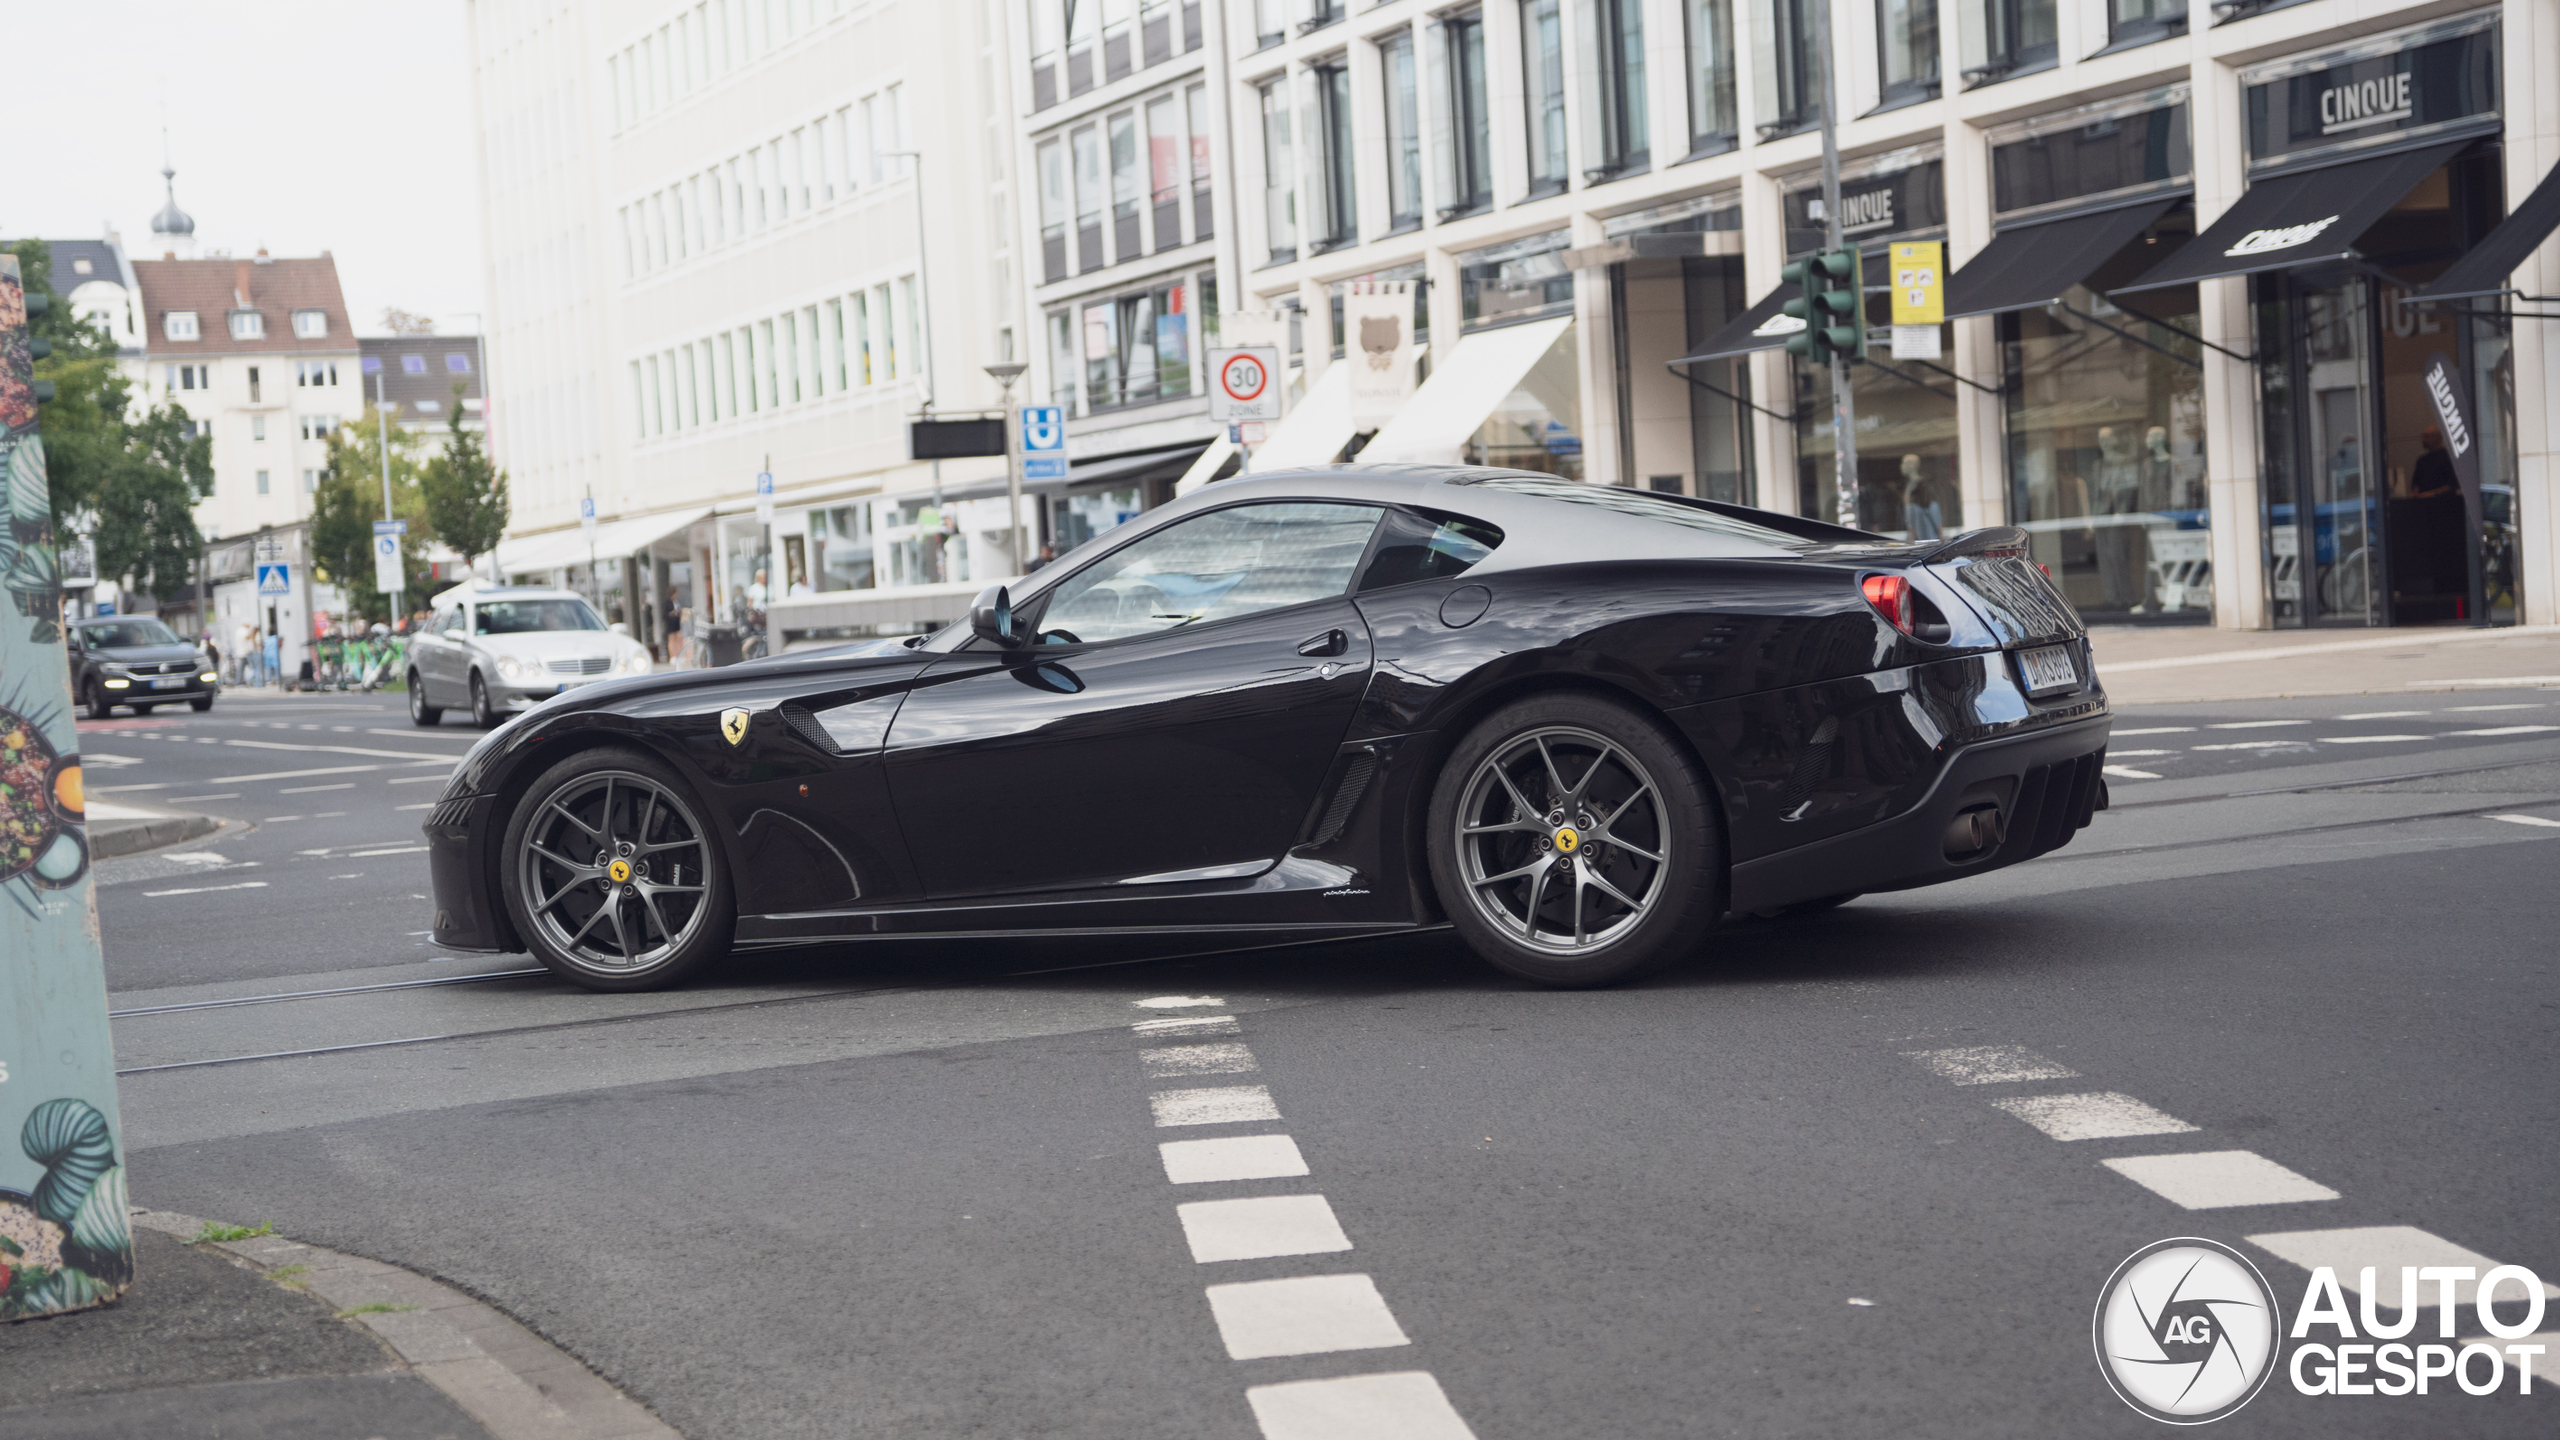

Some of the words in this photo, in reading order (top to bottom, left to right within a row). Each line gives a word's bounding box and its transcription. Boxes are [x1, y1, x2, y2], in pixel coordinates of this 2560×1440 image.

[2321, 72, 2412, 124] CINQUE
[1842, 189, 1893, 227] INQUE
[2230, 214, 2339, 250] CINQUE
[1231, 366, 1258, 388] 30
[1026, 408, 1060, 449] U
[1228, 404, 1264, 416] ZONE
